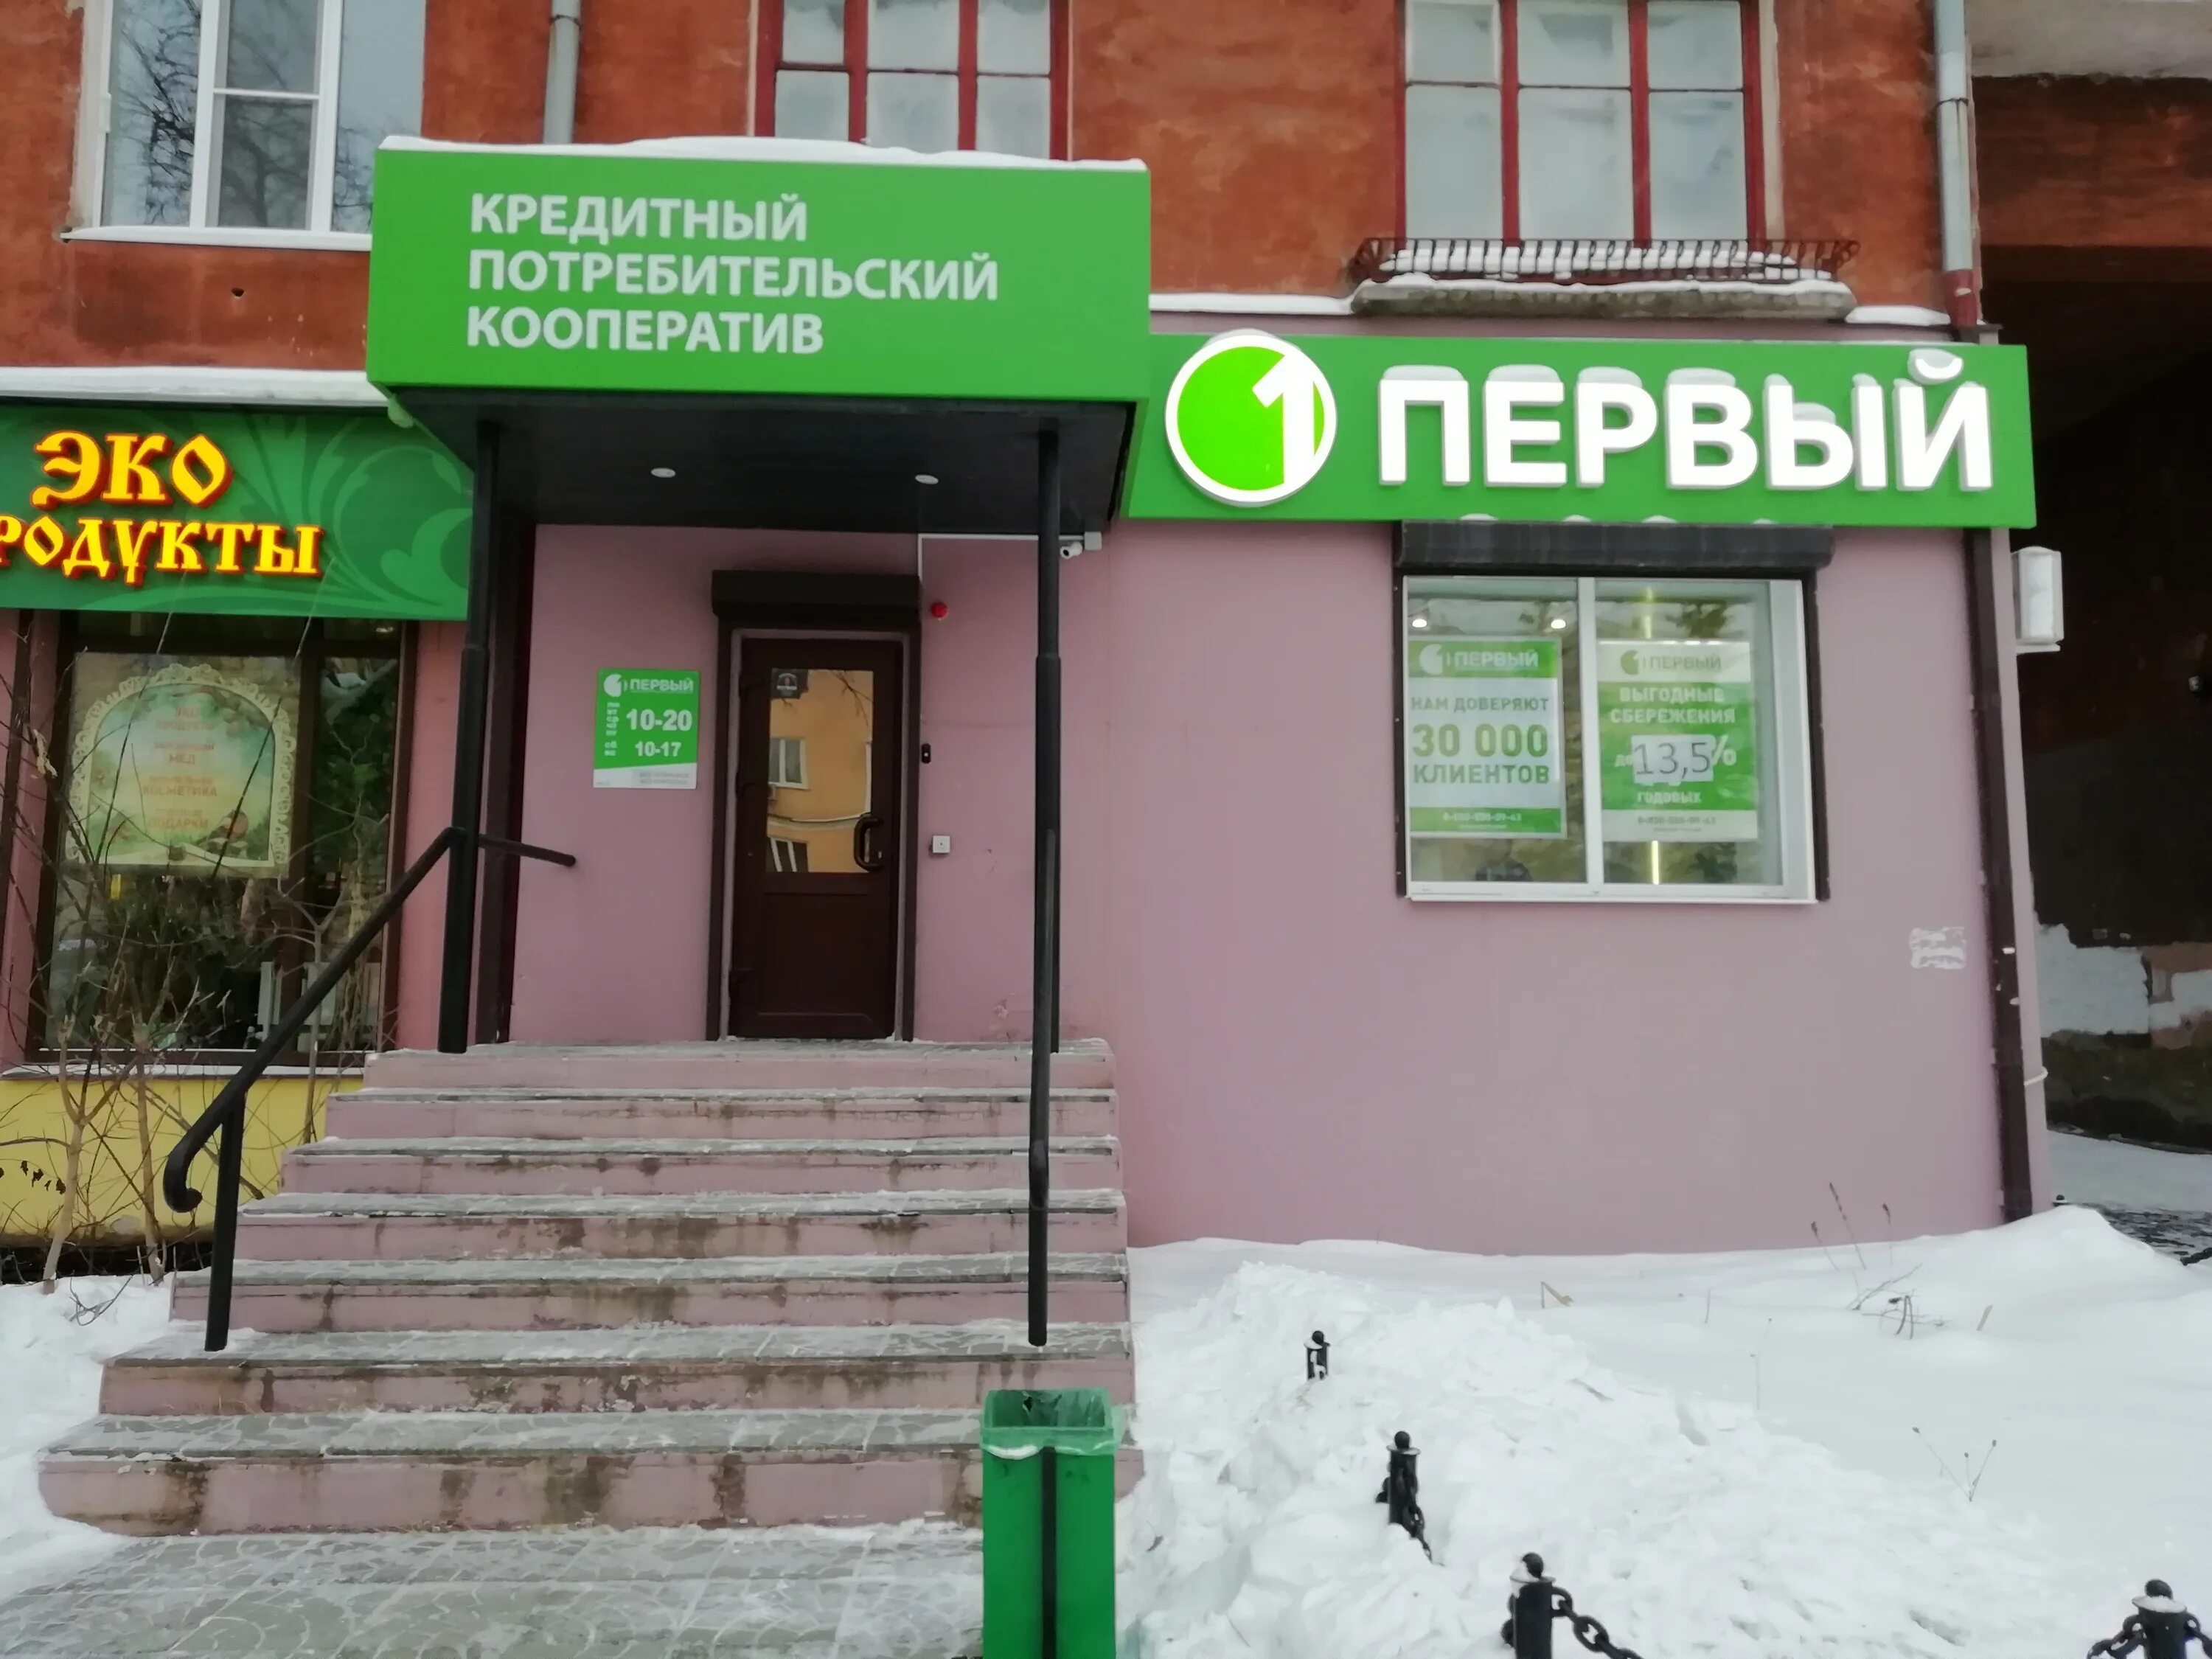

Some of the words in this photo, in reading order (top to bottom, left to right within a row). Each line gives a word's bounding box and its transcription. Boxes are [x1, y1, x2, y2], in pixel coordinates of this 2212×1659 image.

[470, 192, 807, 245] КРЕДИТНЫЙ
[468, 249, 999, 301] ПОТРЕБИТЕЛЬСКИЙ
[466, 306, 824, 354] КООПЕРАТИВ
[1377, 352, 1993, 493] ПЕРВЫЙ
[29, 431, 233, 509] ЭКО
[1454, 649, 1539, 668] ПЕРВЫЙ
[1650, 653, 1722, 669] ПЕРВЫЙ
[630, 677, 694, 693] ПЕРВЫЙ
[1619, 686, 1725, 704] ВЫГОДНЫЕ
[1411, 697, 1449, 710] НАМ
[1454, 697, 1549, 713] ДОВЕРЯЮТ
[626, 708, 693, 732] 10-20
[1610, 708, 1736, 723] СБЕРЕЖЕНИЯ
[635, 740, 682, 757] 10-17
[1412, 723, 1461, 757] 30
[1474, 723, 1548, 757] 000
[1413, 764, 1551, 784] КЛИЕНТОВ
